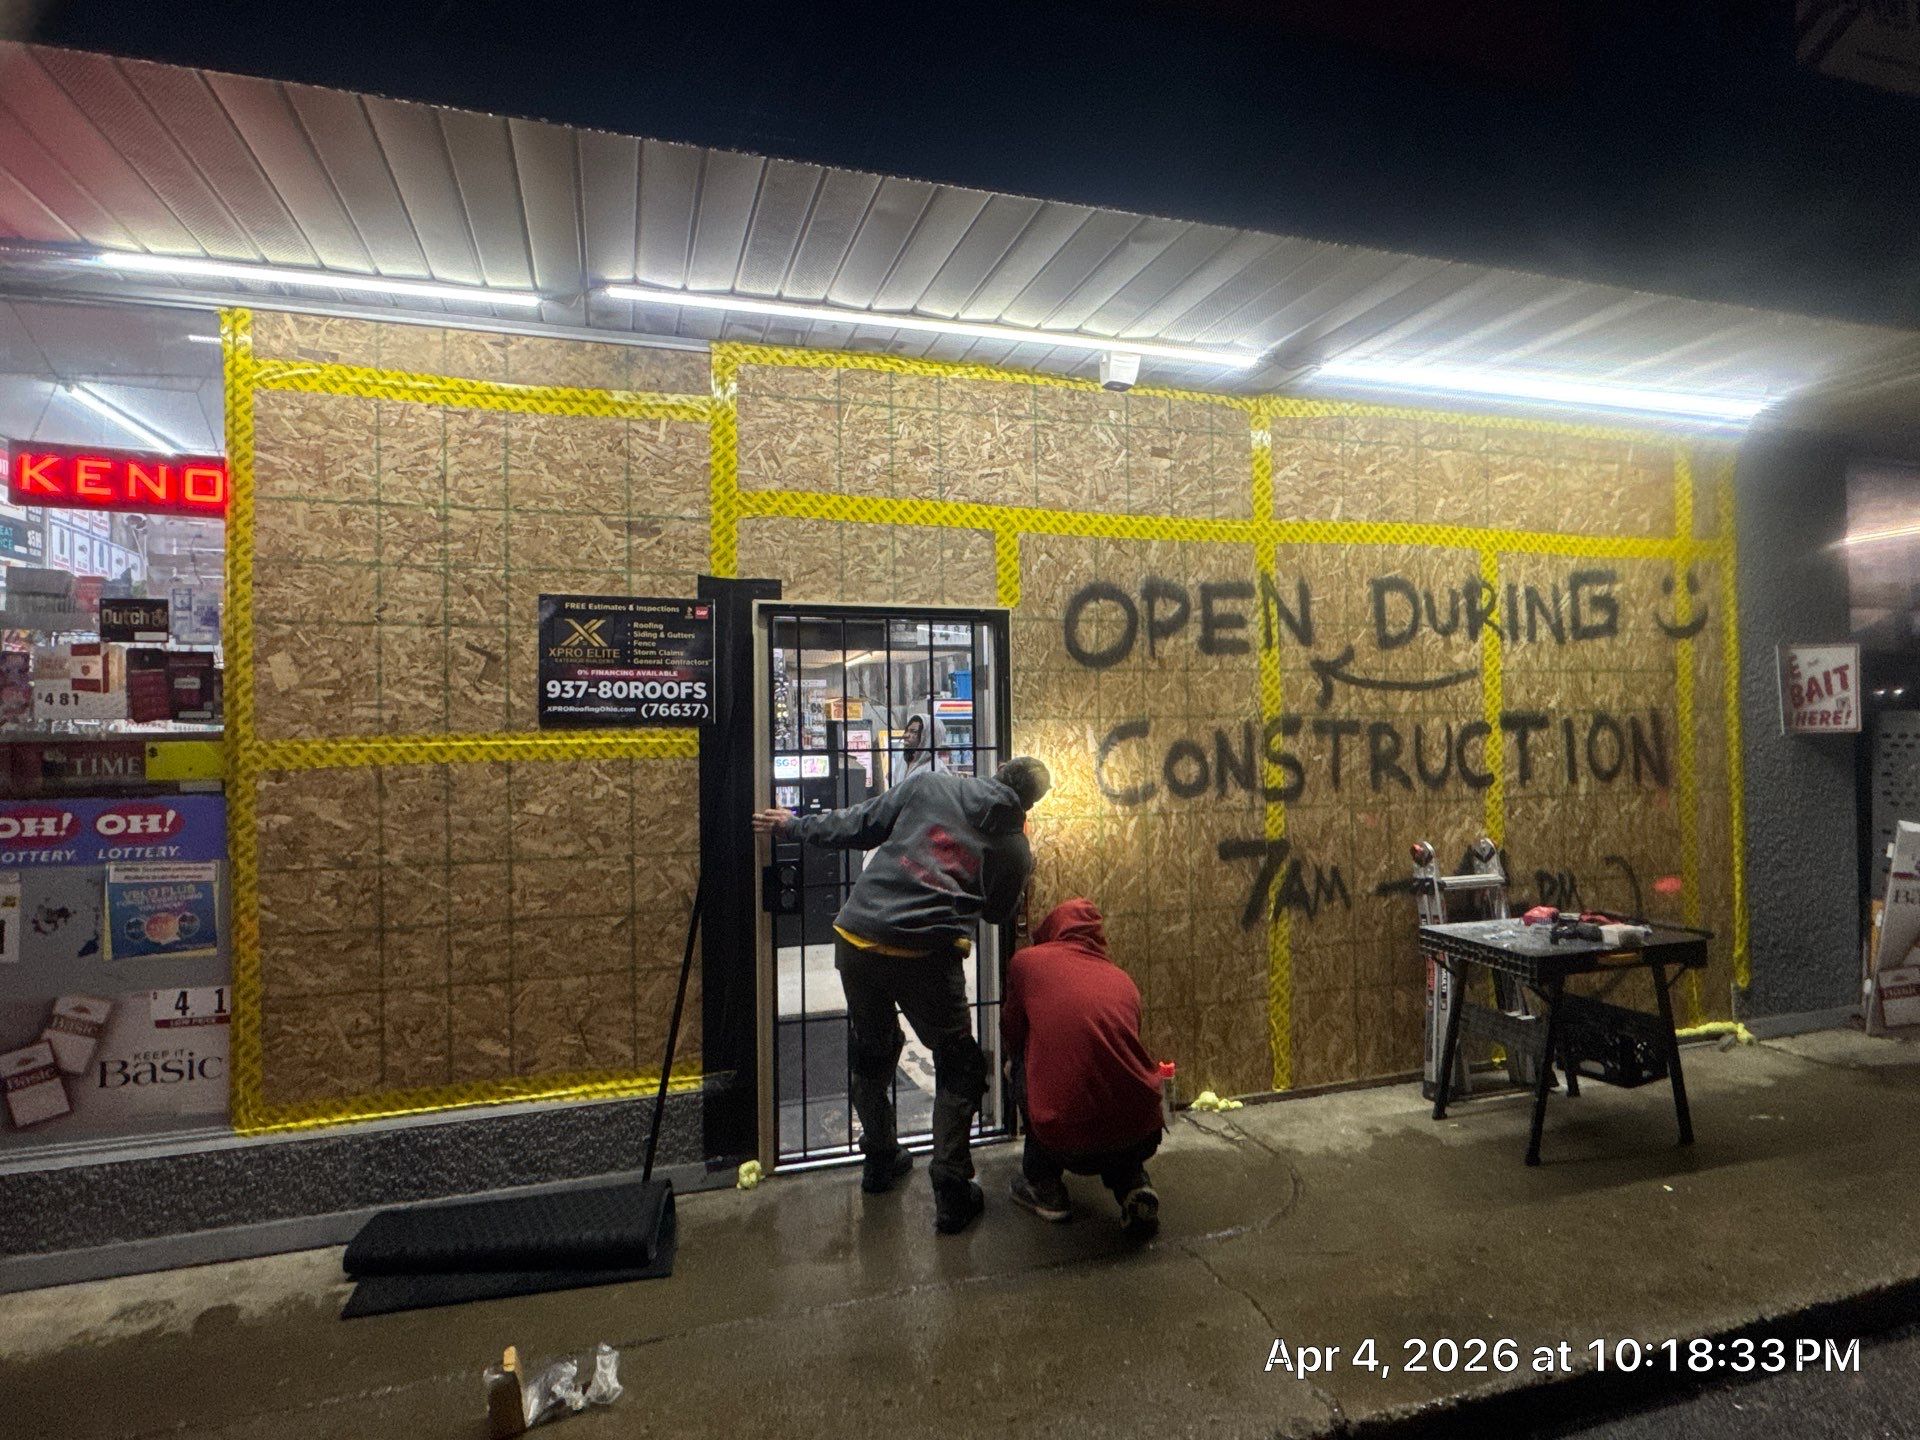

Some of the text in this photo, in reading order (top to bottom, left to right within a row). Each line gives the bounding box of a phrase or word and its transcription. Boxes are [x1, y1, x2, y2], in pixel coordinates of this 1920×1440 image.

[18, 454, 226, 503] KENO
[102, 607, 150, 625] Dutch
[564, 602, 586, 610] FREE
[588, 603, 627, 612] Estimates
[636, 604, 681, 613] Inspections
[633, 622, 664, 630] Roofing
[1064, 569, 1619, 668] OPEN DURING
[633, 631, 659, 640] Siding
[667, 631, 696, 639] Gutters
[549, 648, 621, 659] XPRO ELITE
[633, 658, 663, 666] General
[659, 649, 685, 657] Claims
[590, 669, 634, 677] FINANCING
[546, 680, 707, 699] 937-80ROOFS
[1790, 664, 1850, 708] BAIT
[640, 703, 709, 719] (76637)
[1795, 709, 1852, 727] HERE!
[1095, 706, 1670, 803] CONSTRUCTION
[74, 756, 142, 776] TIME
[0, 812, 73, 839] OH!
[95, 808, 177, 836] OH!
[98, 845, 180, 861] LOTTERY
[1217, 839, 1352, 931] 7AM
[133, 1048, 185, 1061] KEEP IT
[98, 1051, 223, 1089] Basic
